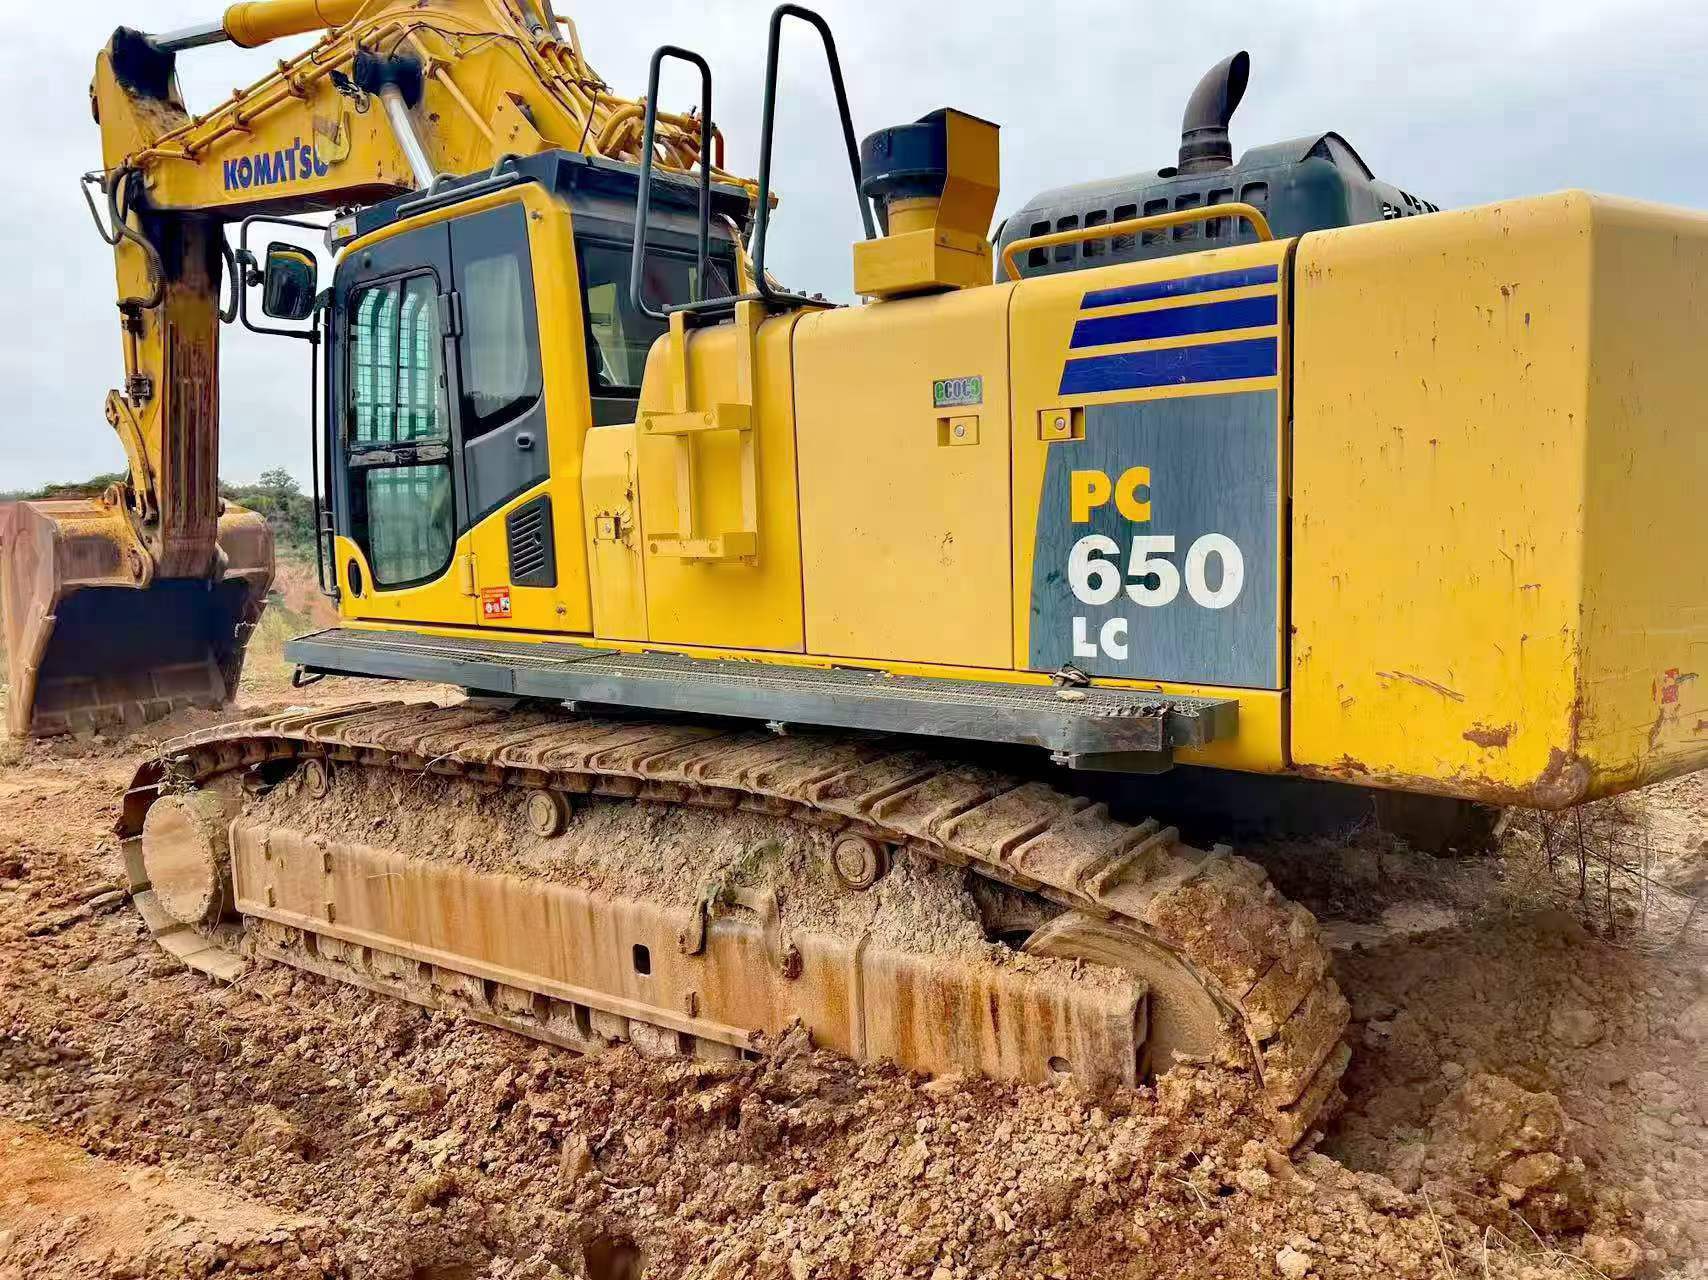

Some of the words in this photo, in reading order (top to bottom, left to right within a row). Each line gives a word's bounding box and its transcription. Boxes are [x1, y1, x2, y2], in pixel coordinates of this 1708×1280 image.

[1071, 466, 1151, 523] PC
[1068, 532, 1245, 609] 650
[1072, 616, 1128, 660] LC
